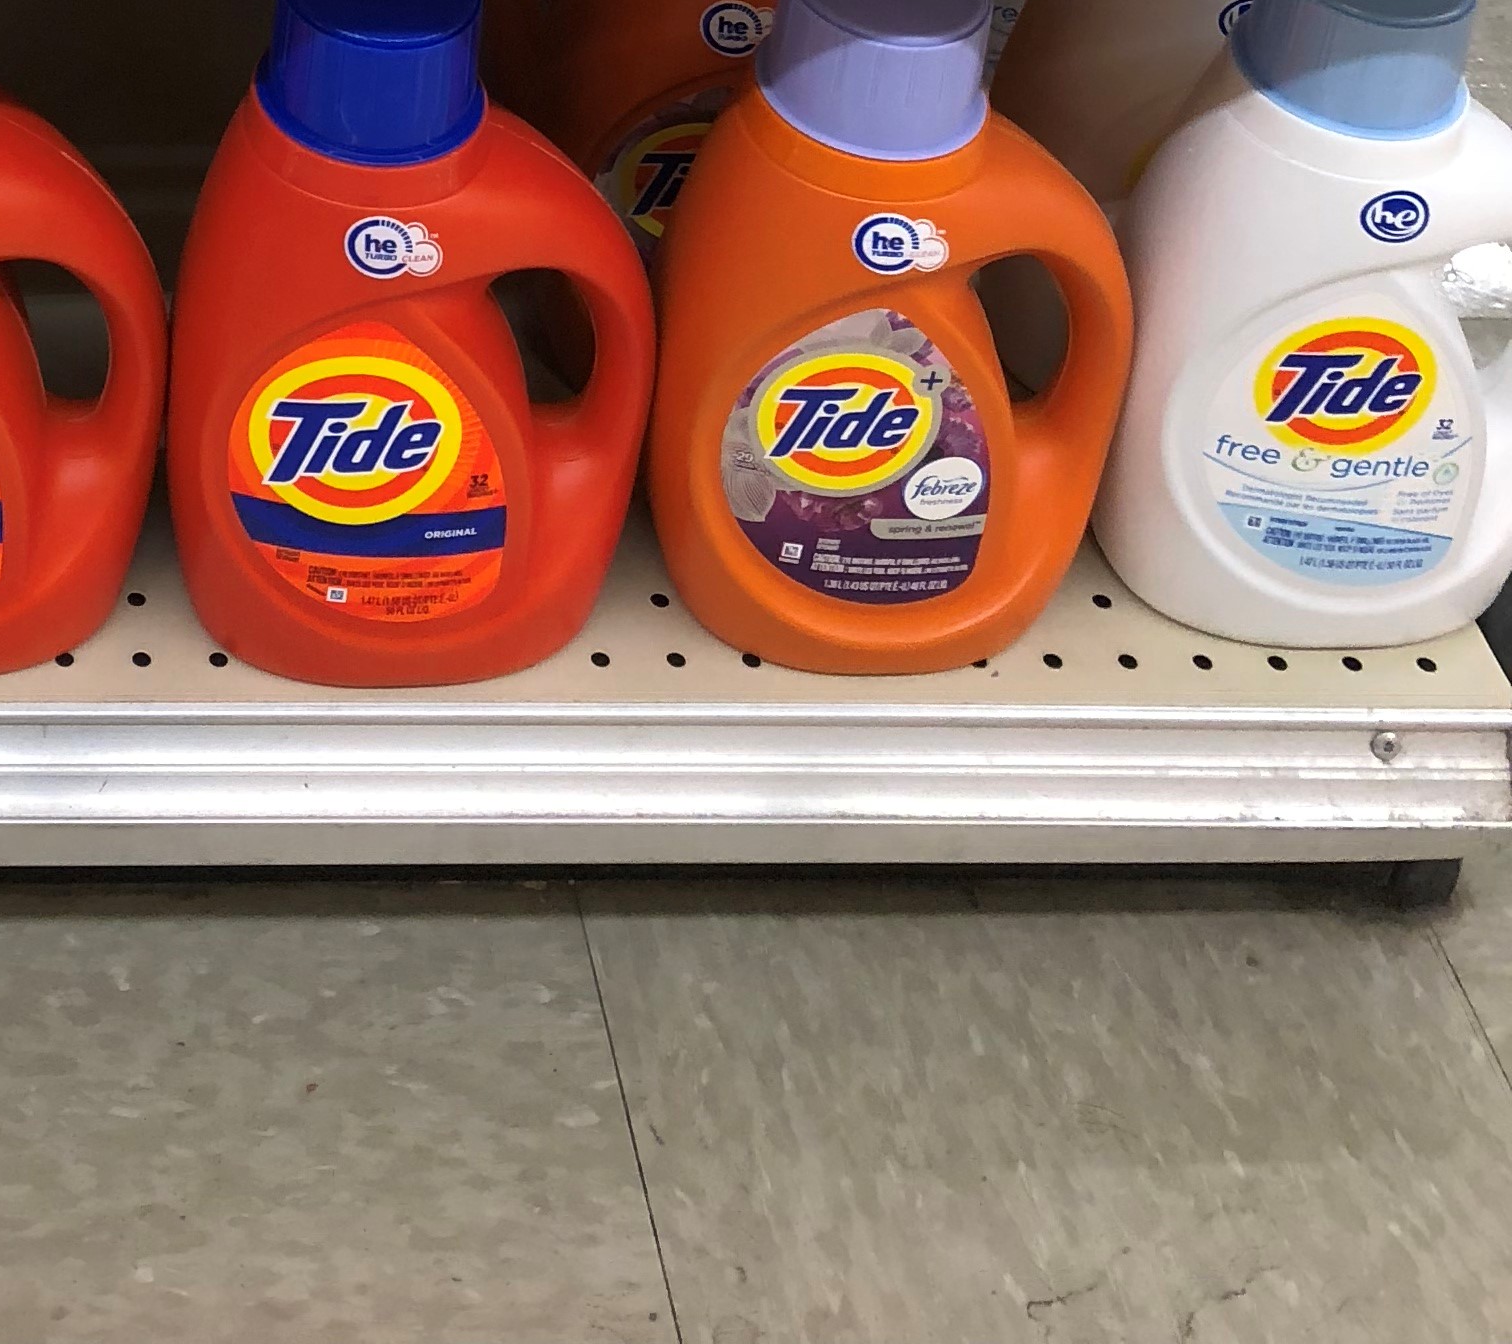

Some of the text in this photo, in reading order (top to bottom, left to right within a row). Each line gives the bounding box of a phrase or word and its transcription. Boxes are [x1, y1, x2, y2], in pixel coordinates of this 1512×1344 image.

[718, 16, 748, 35] he
[1372, 199, 1418, 231] he
[365, 233, 397, 254] he
[872, 231, 904, 250] he
[401, 254, 434, 264] CLEAN
[1264, 353, 1424, 423] Tide
[764, 387, 919, 459] Tide
[262, 398, 444, 485] Tide
[1216, 433, 1281, 465] free
[1330, 455, 1430, 479] gentle
[469, 474, 489, 489] 32
[909, 476, 978, 500] febreze
[424, 527, 478, 540] ORIGINAL
